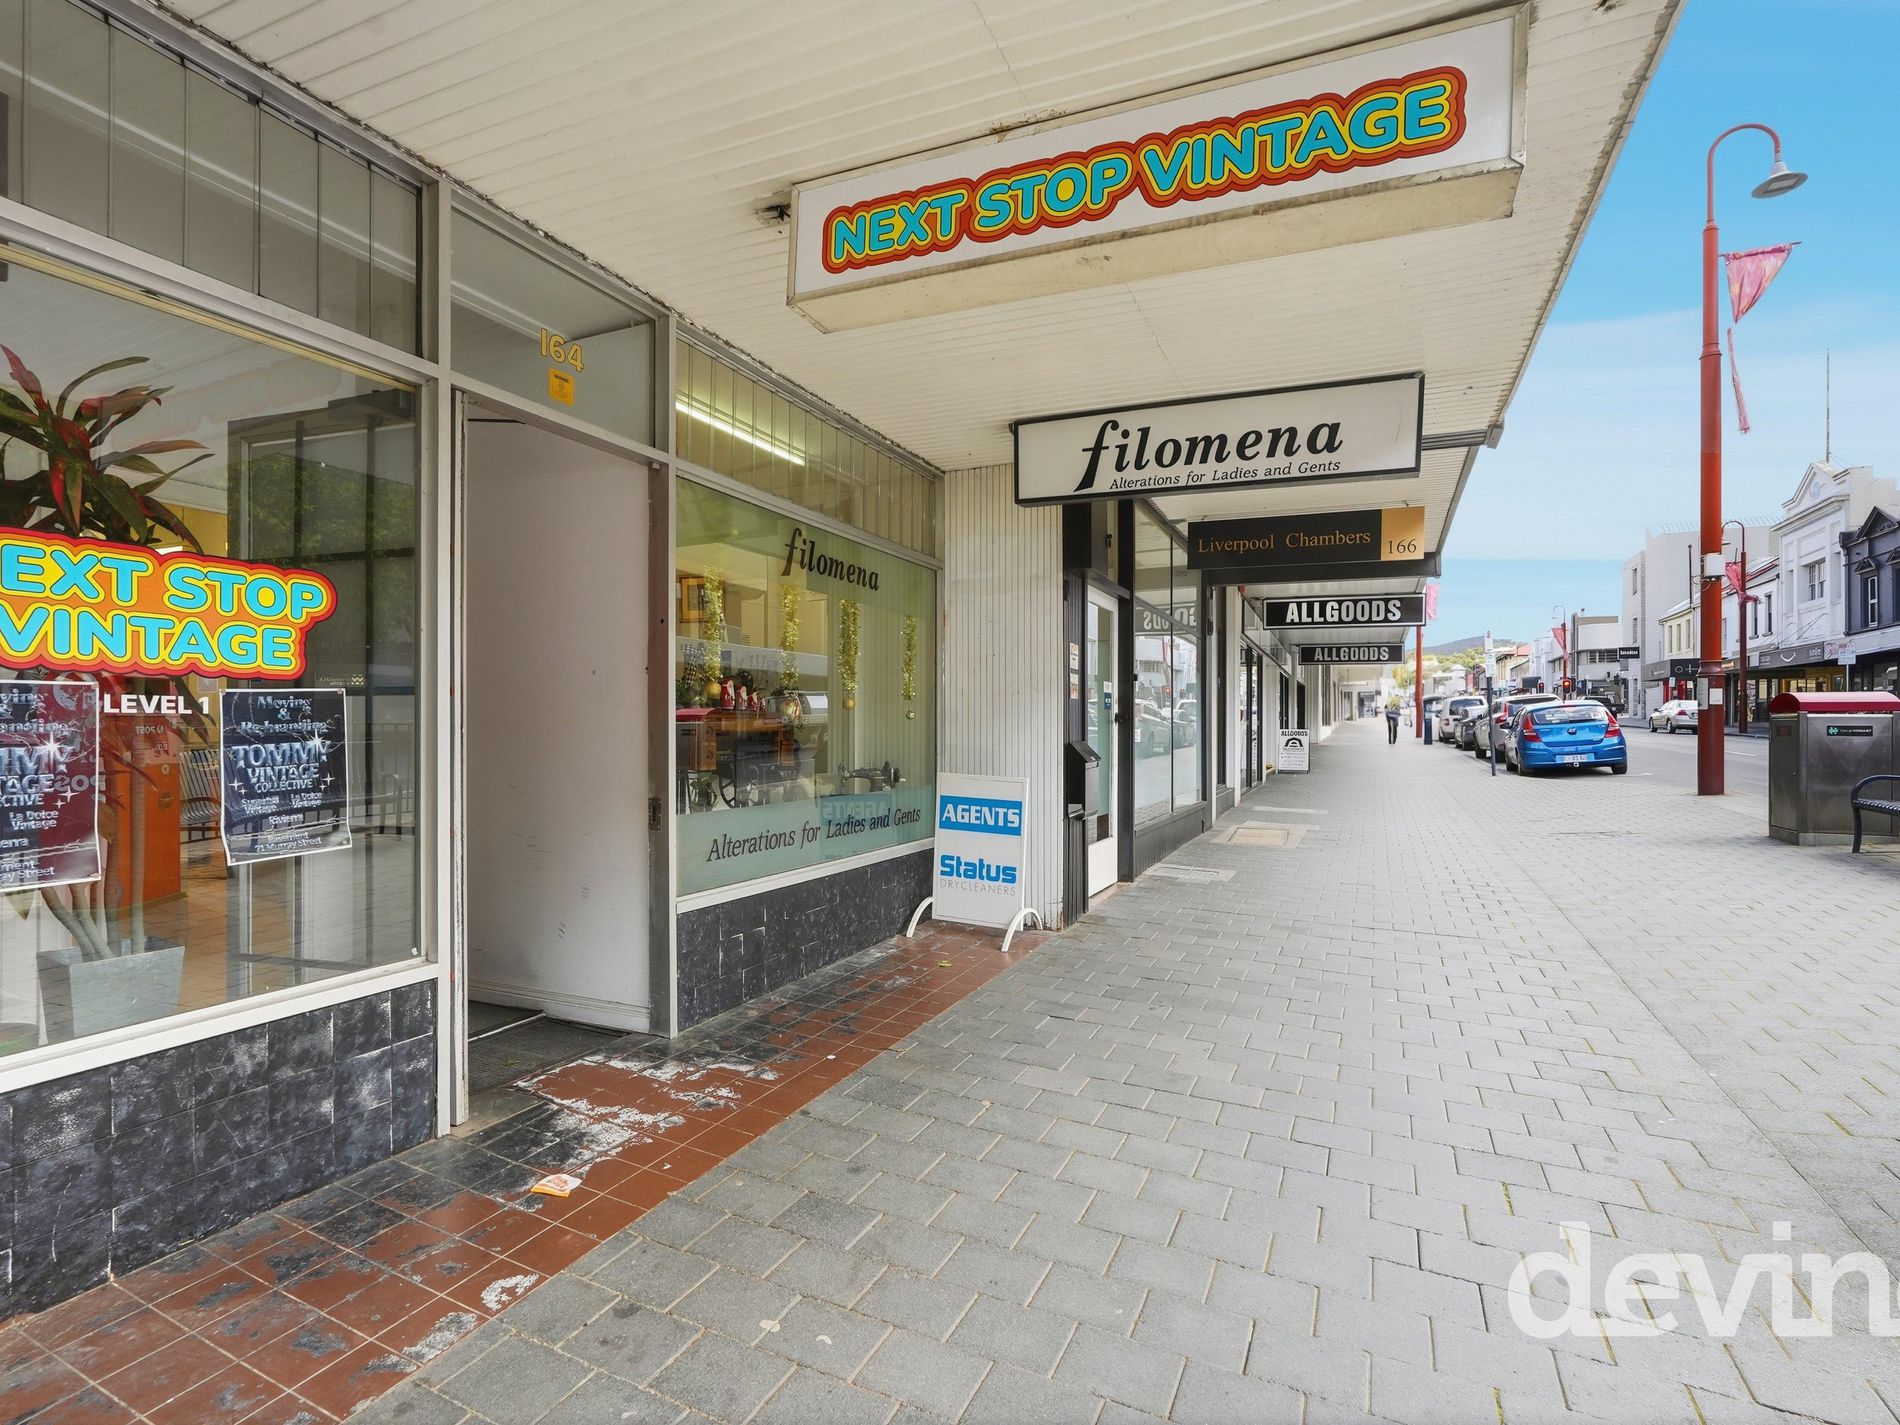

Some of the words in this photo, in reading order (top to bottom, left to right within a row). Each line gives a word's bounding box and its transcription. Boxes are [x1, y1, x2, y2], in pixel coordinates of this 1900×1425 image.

[833, 192, 966, 262] NEXT
[976, 156, 1130, 229] STOP
[1142, 84, 1447, 193] VINTAGE
[541, 328, 584, 372] 164
[1073, 419, 1343, 492] filomena
[1110, 473, 1180, 490] Alterations
[1186, 471, 1206, 486] for
[1212, 464, 1258, 481] Ladies
[1264, 462, 1292, 477] and
[1298, 460, 1341, 474] Gents
[1198, 534, 1275, 554] Liverpool
[1286, 530, 1371, 548] Chambers
[1388, 538, 1417, 554] 166
[781, 527, 880, 592] filomena
[1, 545, 149, 603] EXT
[167, 566, 323, 620] STOP
[1285, 600, 1402, 623] ALLGOODS
[0, 604, 292, 667] VINTAGE
[1314, 647, 1389, 661] ALLGOODS
[104, 694, 192, 714] LEVEL
[198, 697, 209, 714] 1
[231, 740, 331, 768] TOMMY
[246, 763, 320, 784] VINTAGE
[255, 779, 313, 793] COLLECTIVE
[942, 803, 1020, 828] AGENTS
[706, 829, 796, 863] Alterations
[800, 820, 820, 849] for
[826, 814, 866, 839] Ladies
[870, 808, 891, 829] and
[893, 808, 920, 826] Gents
[940, 855, 1017, 884] Status
[940, 879, 1017, 896] DRYCLEANERS
